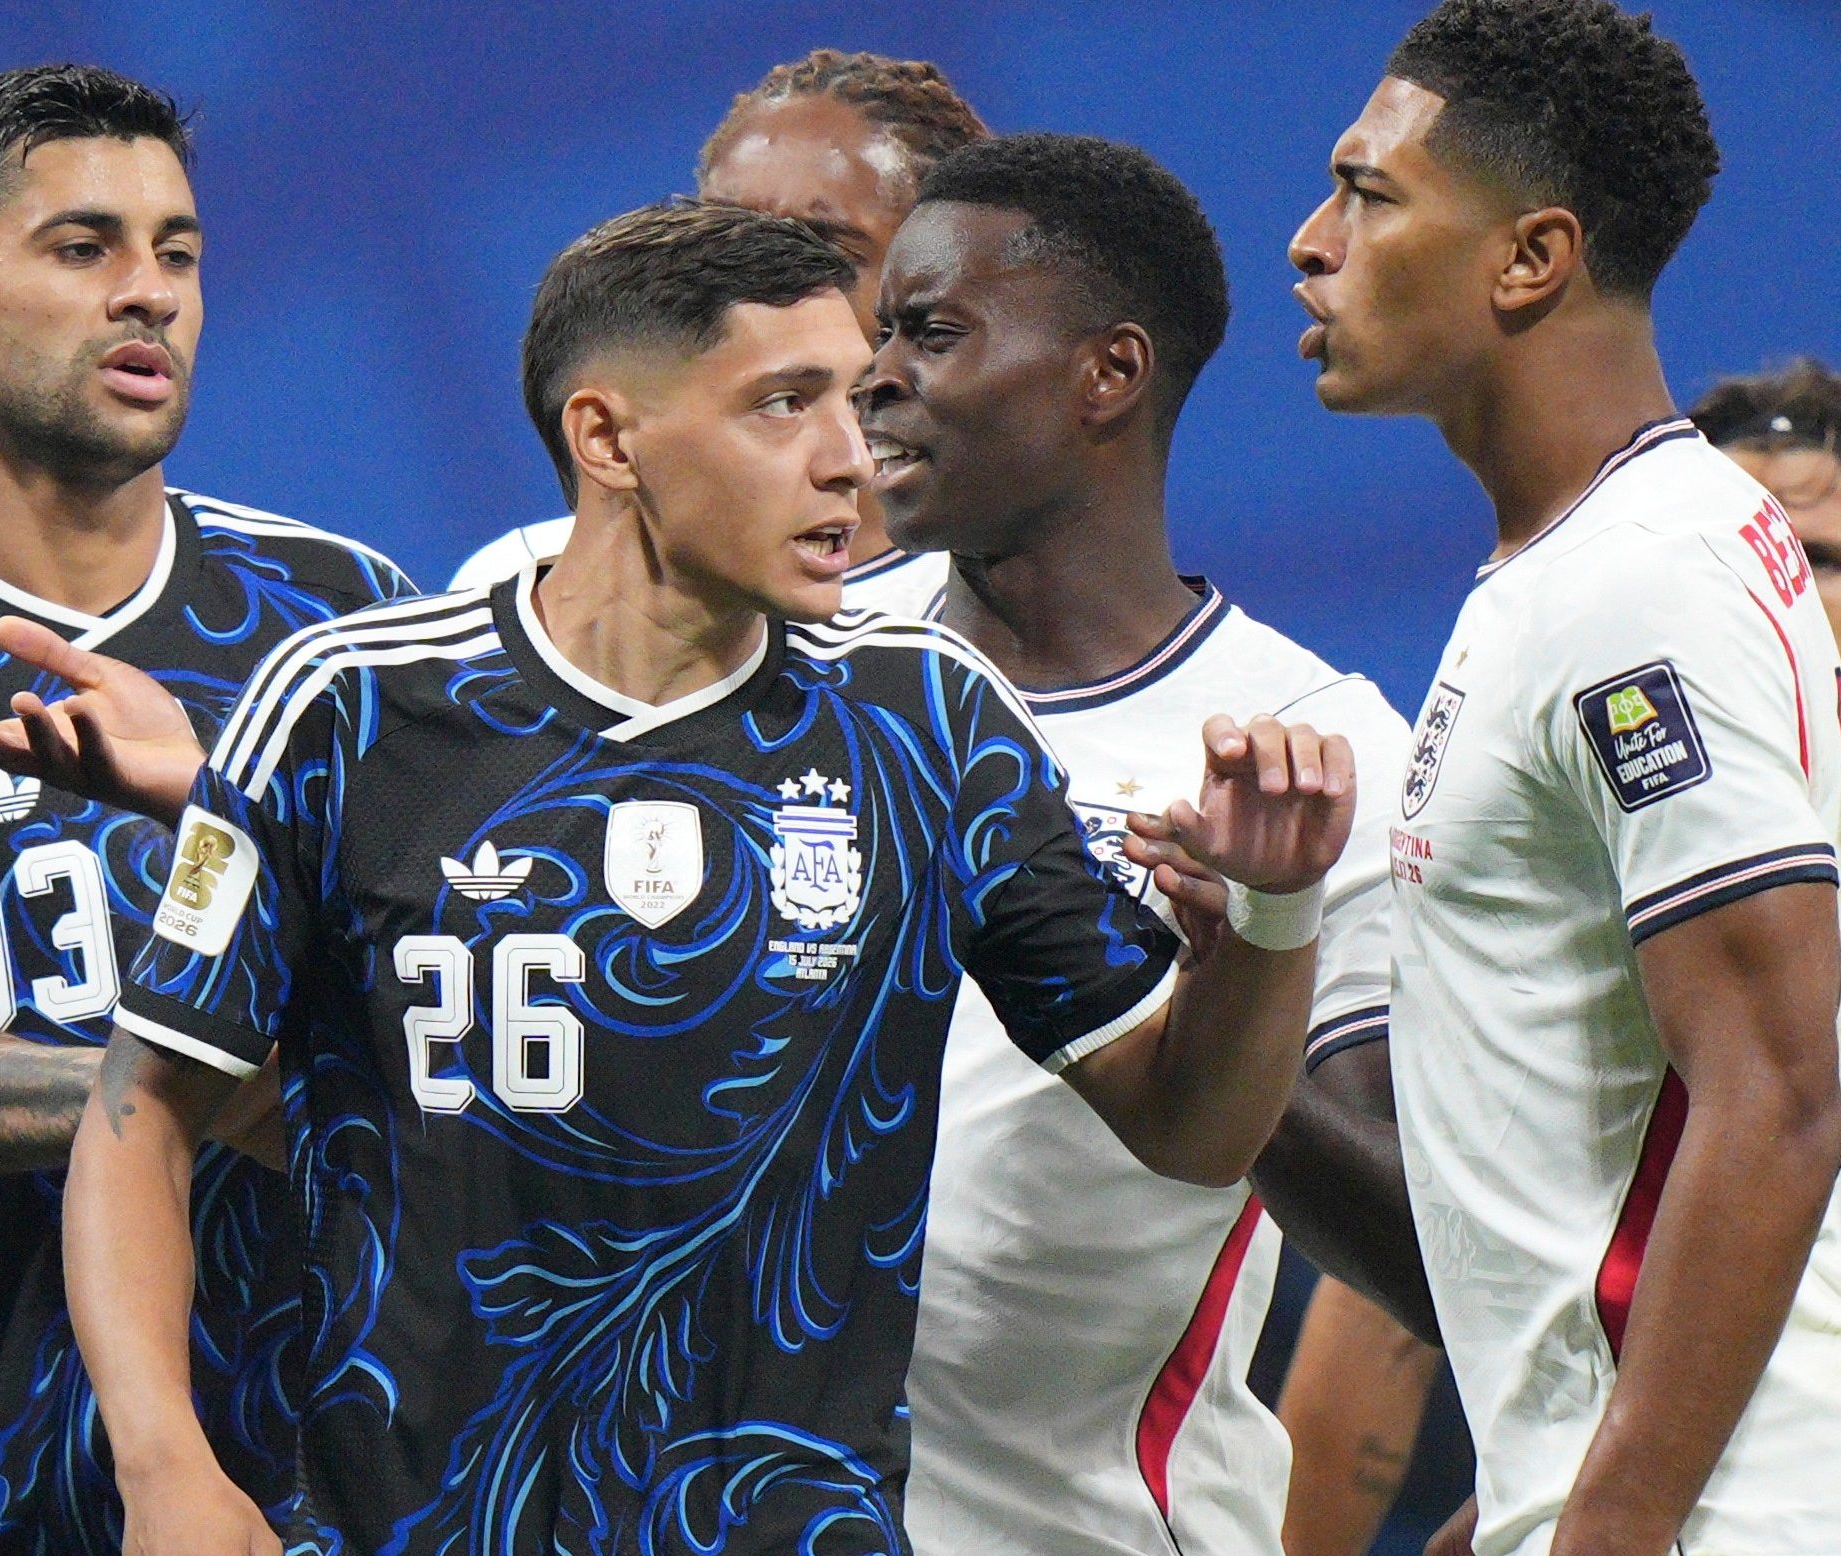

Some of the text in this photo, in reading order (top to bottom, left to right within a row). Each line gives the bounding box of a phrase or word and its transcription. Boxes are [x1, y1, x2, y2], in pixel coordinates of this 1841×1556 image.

[1614, 721, 1667, 760] Unite For
[1616, 739, 1689, 784] EDUCATION
[1641, 772, 1670, 791] FIFA
[791, 838, 843, 892] AFA
[176, 886, 198, 903] FIFA
[633, 880, 674, 894] FIFA
[640, 901, 666, 909] 2022
[158, 912, 199, 937] 2026
[393, 934, 586, 1114] 26
